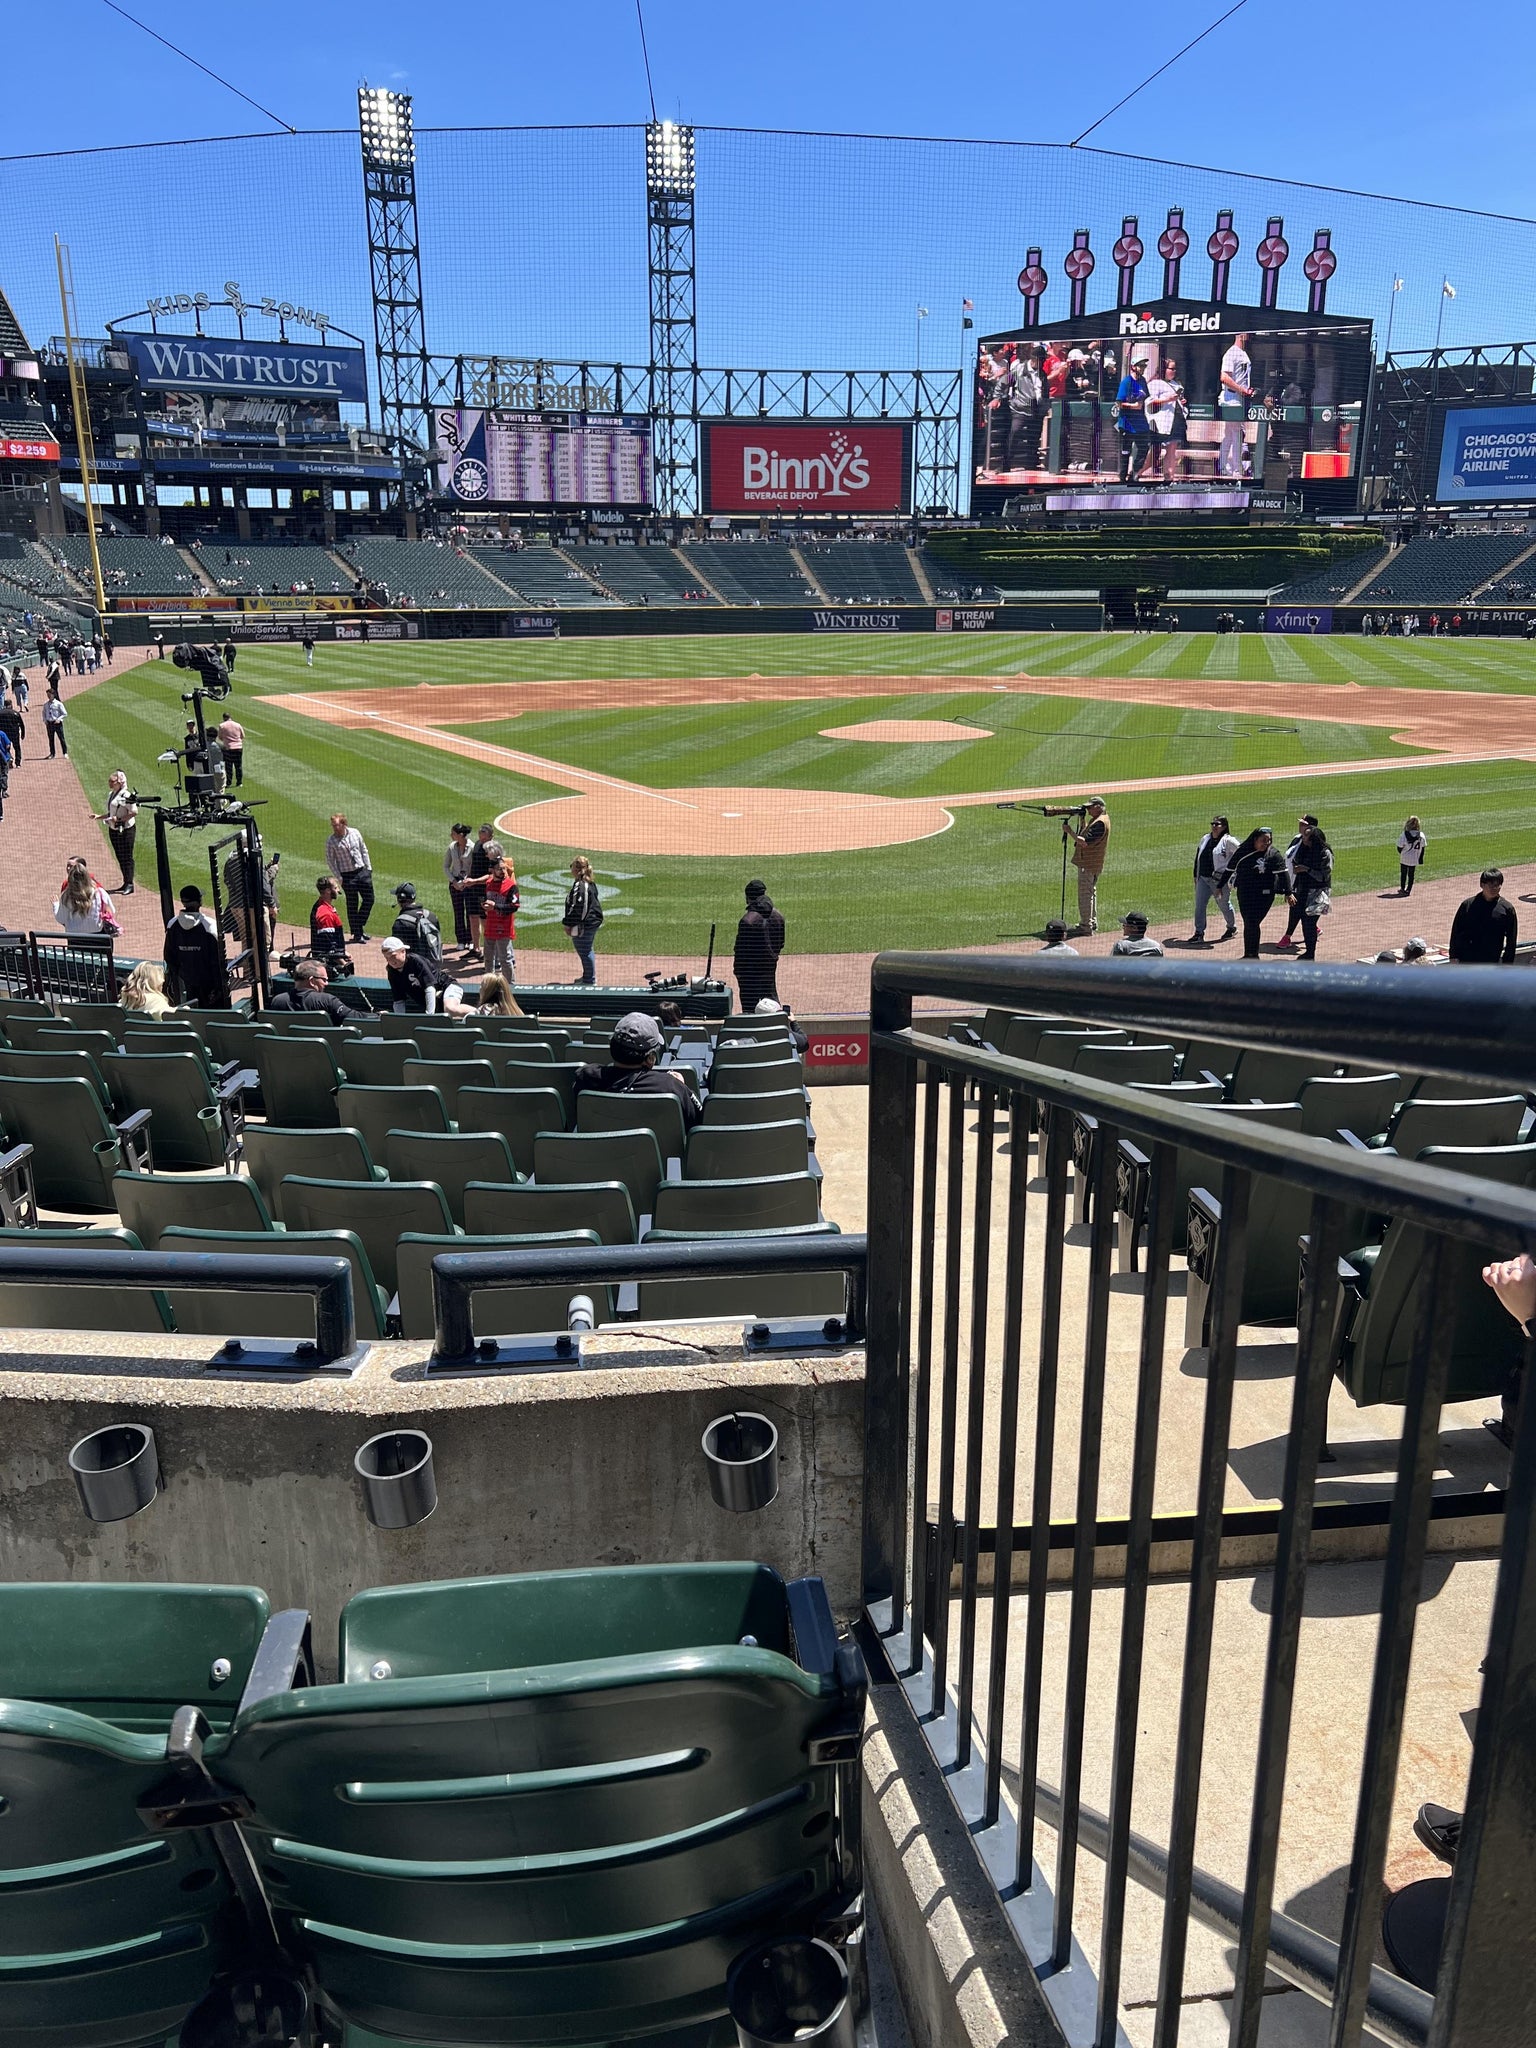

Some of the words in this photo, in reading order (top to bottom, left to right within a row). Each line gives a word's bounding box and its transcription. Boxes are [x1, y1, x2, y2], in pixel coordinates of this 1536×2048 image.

[147, 292, 211, 318] KIDS
[261, 297, 330, 333] ZONE
[1119, 312, 1167, 334] Rate
[1170, 312, 1220, 332] Field
[142, 340, 342, 387] WINTRUST
[470, 359, 555, 379] CAESARS
[471, 380, 613, 412] SPORTSBOOK
[502, 414, 526, 422] WHITE
[527, 415, 543, 423] SOX
[586, 417, 624, 426] MARINERS
[1464, 432, 1536, 447] CHICAGO'S
[10, 443, 47, 456] $2,259
[1463, 446, 1536, 460] HOMETOWN
[74, 458, 124, 470] WNTRUST
[210, 461, 246, 469] Hometown
[247, 462, 275, 471] Banking
[1461, 460, 1510, 472] AIRLINE
[744, 491, 788, 500] BEVERAGE
[789, 491, 818, 500] DEPOT
[1020, 504, 1029, 512] FAN
[1030, 503, 1043, 512] DECK
[1253, 500, 1265, 508] FAN
[1265, 500, 1282, 509] DECK
[592, 510, 625, 523] Modelo
[264, 599, 293, 607] Vienna
[295, 598, 314, 606] Beef
[813, 612, 900, 628] WINTRUST
[954, 611, 994, 620] STREAM
[1466, 611, 1490, 620] THE
[531, 617, 553, 628] MLB
[962, 620, 986, 629] NOW
[335, 626, 361, 639] Rate
[812, 1044, 846, 1057] CIBC
